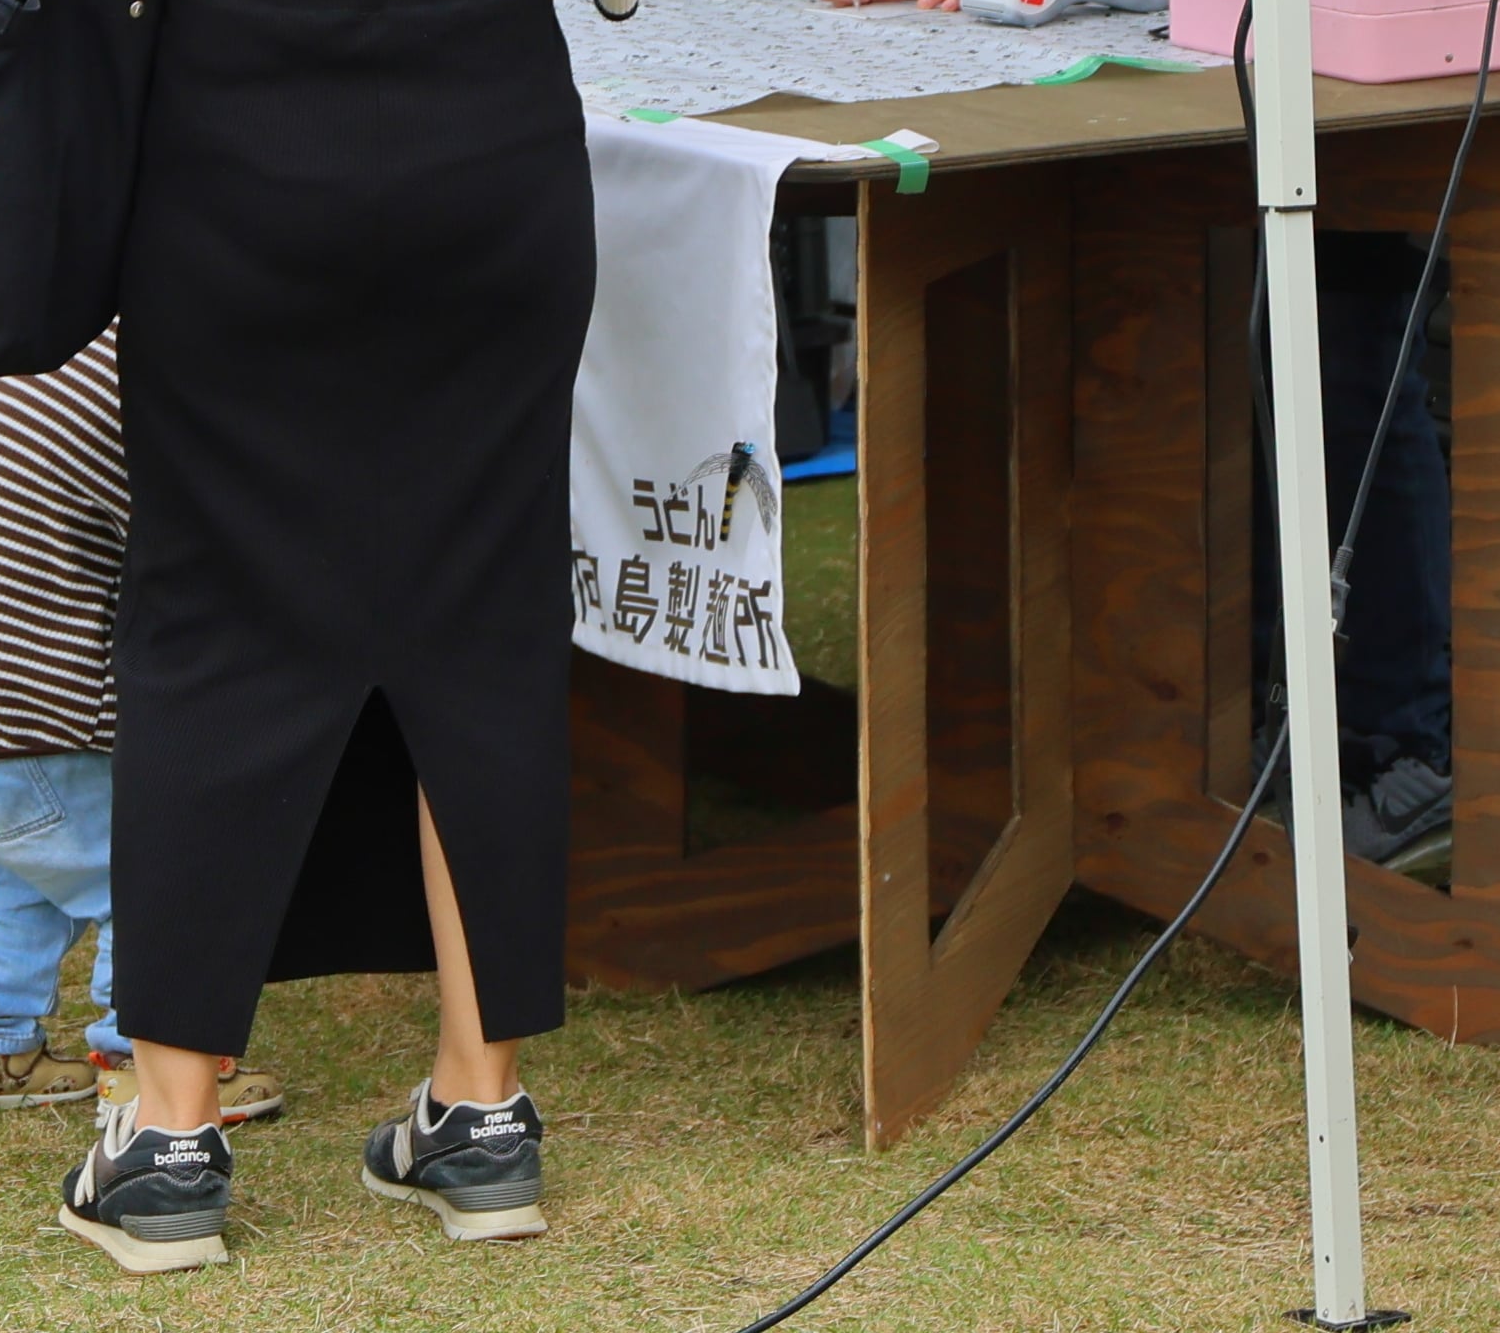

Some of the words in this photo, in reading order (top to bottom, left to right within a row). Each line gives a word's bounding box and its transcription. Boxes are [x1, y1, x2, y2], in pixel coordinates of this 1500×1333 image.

[483, 1110, 514, 1125] new
[469, 1121, 527, 1140] balance
[169, 1139, 199, 1152] new
[153, 1150, 211, 1166] balance
